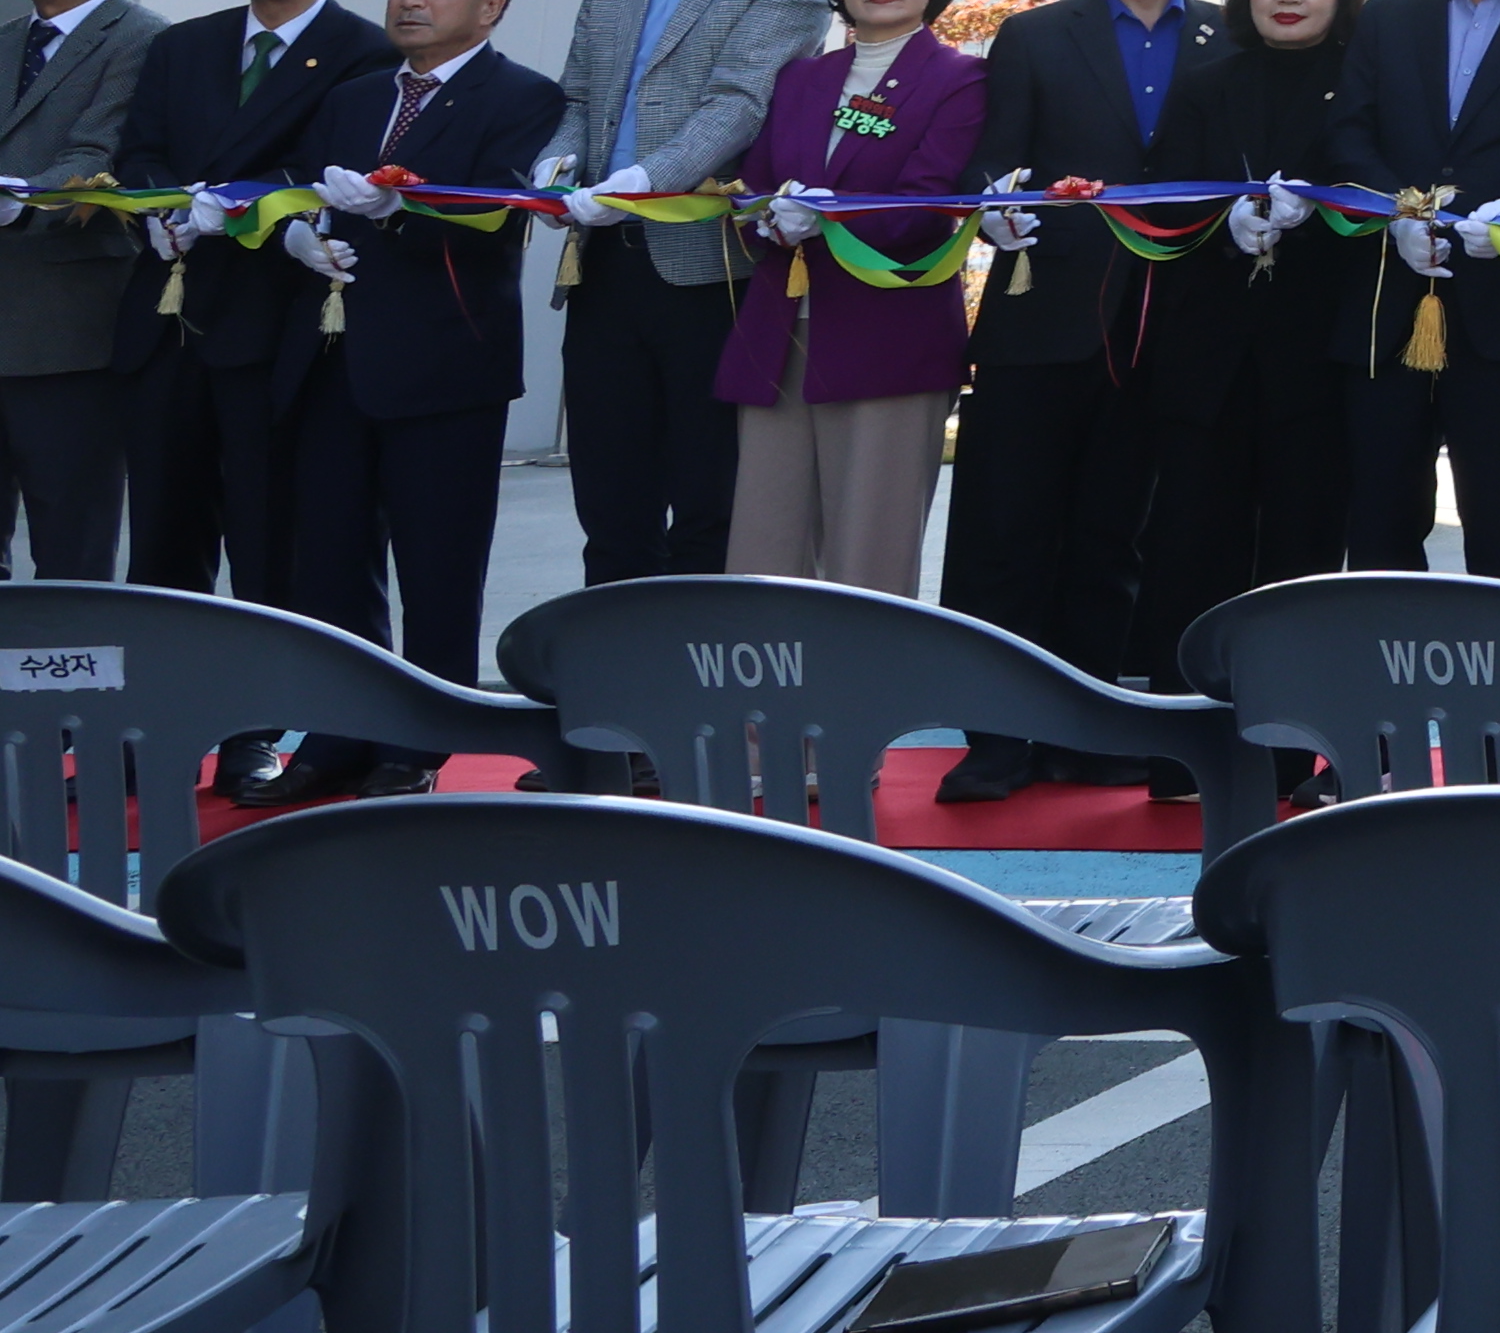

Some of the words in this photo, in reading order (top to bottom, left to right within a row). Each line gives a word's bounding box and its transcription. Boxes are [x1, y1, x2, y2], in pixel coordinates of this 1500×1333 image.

[836, 106, 892, 139] 김정숙
[19, 653, 97, 679] 수상자
[686, 640, 804, 689] WOW
[1378, 638, 1496, 687] WOW
[439, 879, 621, 953] WOW
